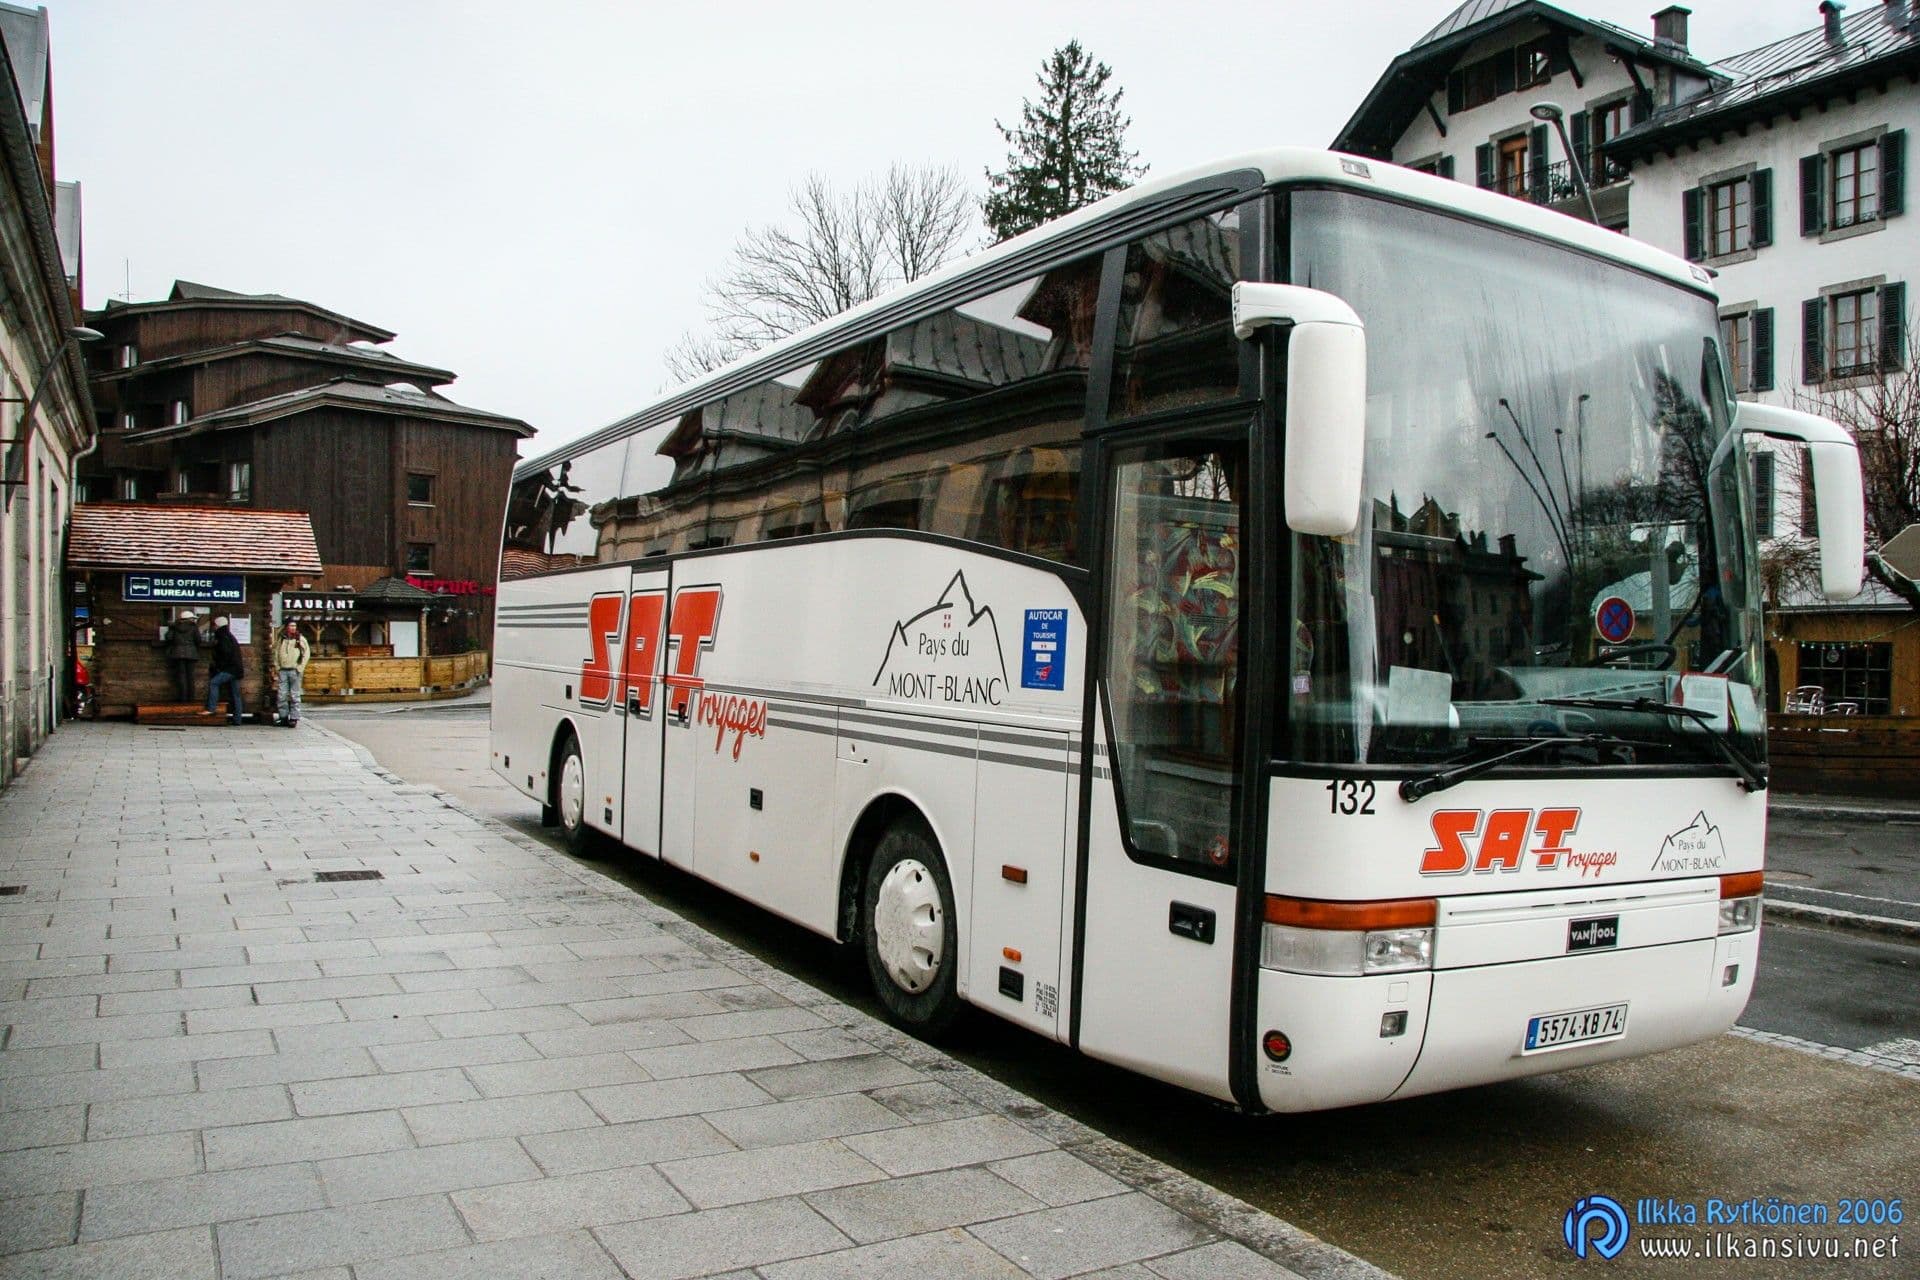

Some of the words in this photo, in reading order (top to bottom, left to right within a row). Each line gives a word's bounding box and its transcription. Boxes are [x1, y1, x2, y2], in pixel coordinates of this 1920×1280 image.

[153, 578, 175, 587] BUS
[177, 579, 213, 588] OFFICE
[153, 588, 195, 597] BUREAU
[213, 590, 240, 598] CARS
[1028, 610, 1063, 621] AUTOCAR
[1041, 622, 1049, 630] DE
[1033, 632, 1057, 640] TOURISME
[918, 632, 946, 663] Pays
[951, 631, 970, 656] du
[579, 584, 724, 729] SAT
[888, 671, 1001, 706] MONT-BLANC
[1326, 779, 1376, 816] 132
[1419, 808, 1581, 876] SAT
[1678, 839, 1695, 852] Pays
[1696, 839, 1706, 850] du
[1660, 856, 1721, 871] MONT-BLANC
[1540, 1016, 1577, 1043] 5574
[1581, 1012, 1600, 1036] XB
[1602, 1009, 1620, 1033] 74
